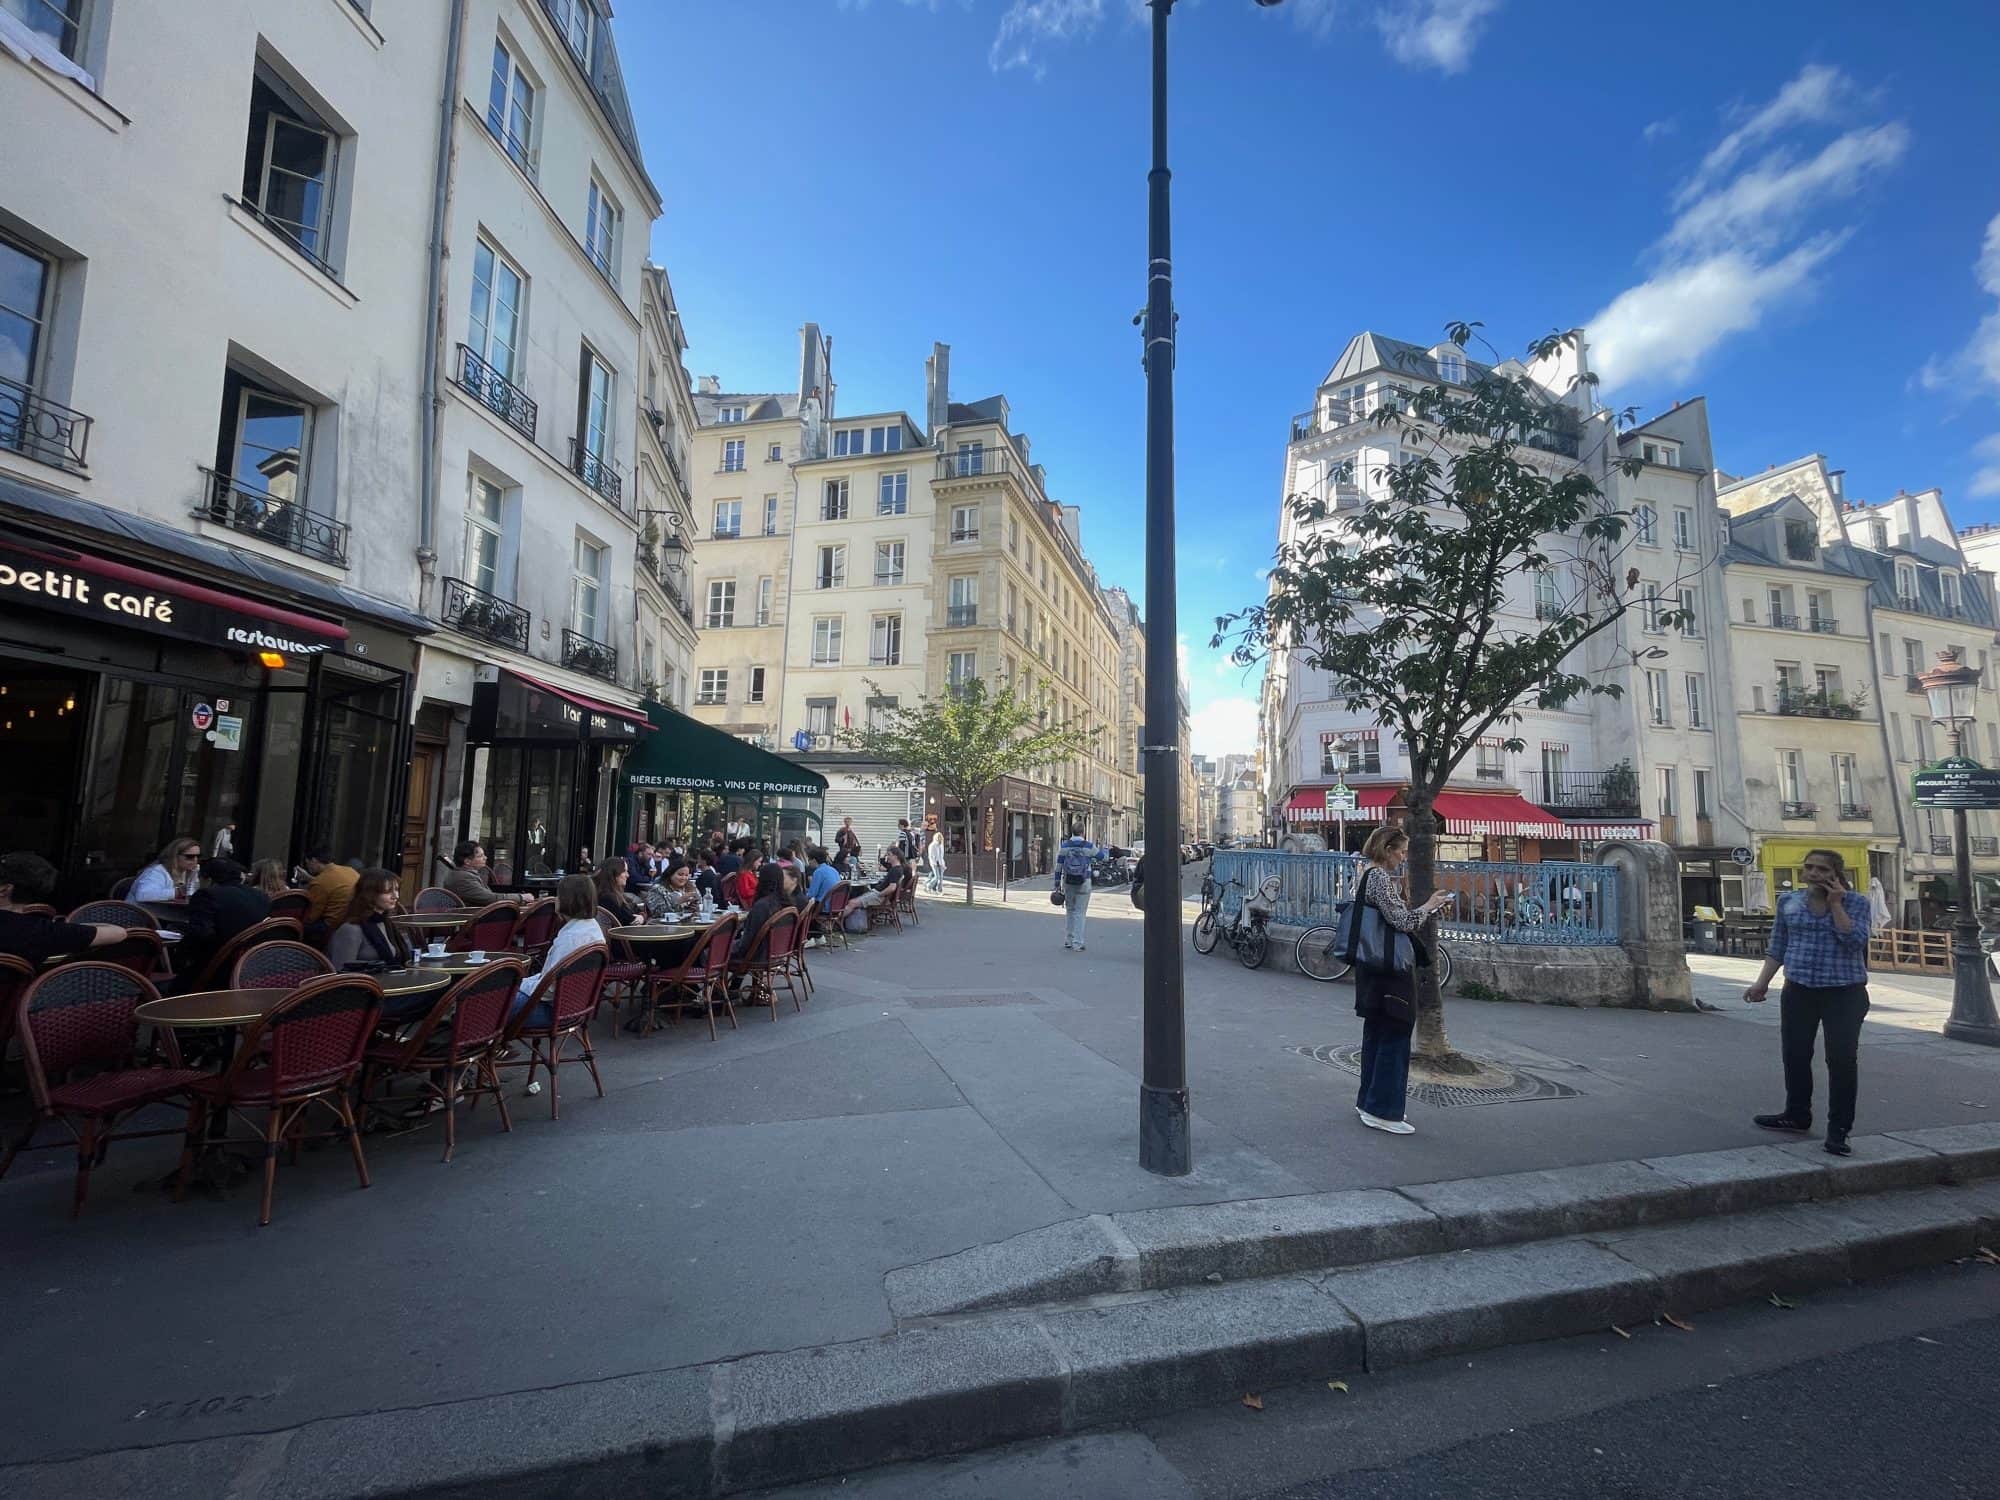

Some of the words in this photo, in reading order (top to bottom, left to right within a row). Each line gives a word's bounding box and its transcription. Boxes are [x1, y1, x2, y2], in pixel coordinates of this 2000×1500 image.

[103, 592, 174, 623] café
[664, 776, 715, 788] PRESSIONS
[724, 780, 746, 790] VINS
[748, 782, 761, 791] DE
